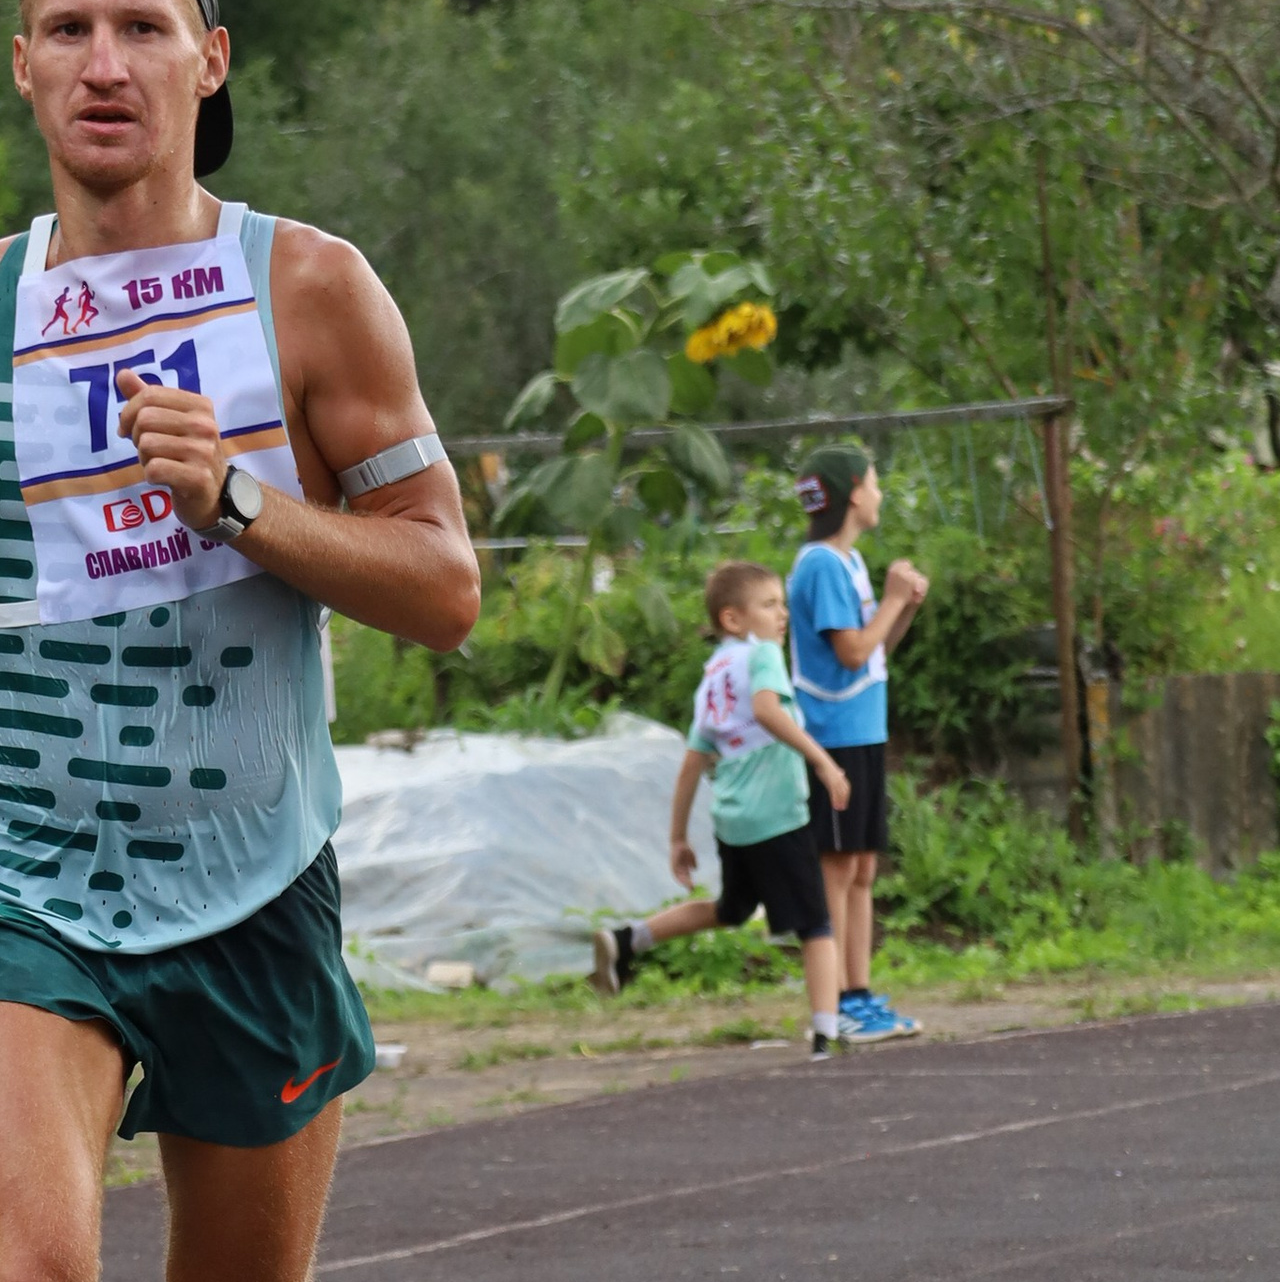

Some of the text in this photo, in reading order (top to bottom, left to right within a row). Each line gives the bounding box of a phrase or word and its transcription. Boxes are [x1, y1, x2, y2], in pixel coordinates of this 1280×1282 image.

[121, 266, 225, 311] 15 КМ
[85, 527, 193, 580] СЛАВНЫЙ
